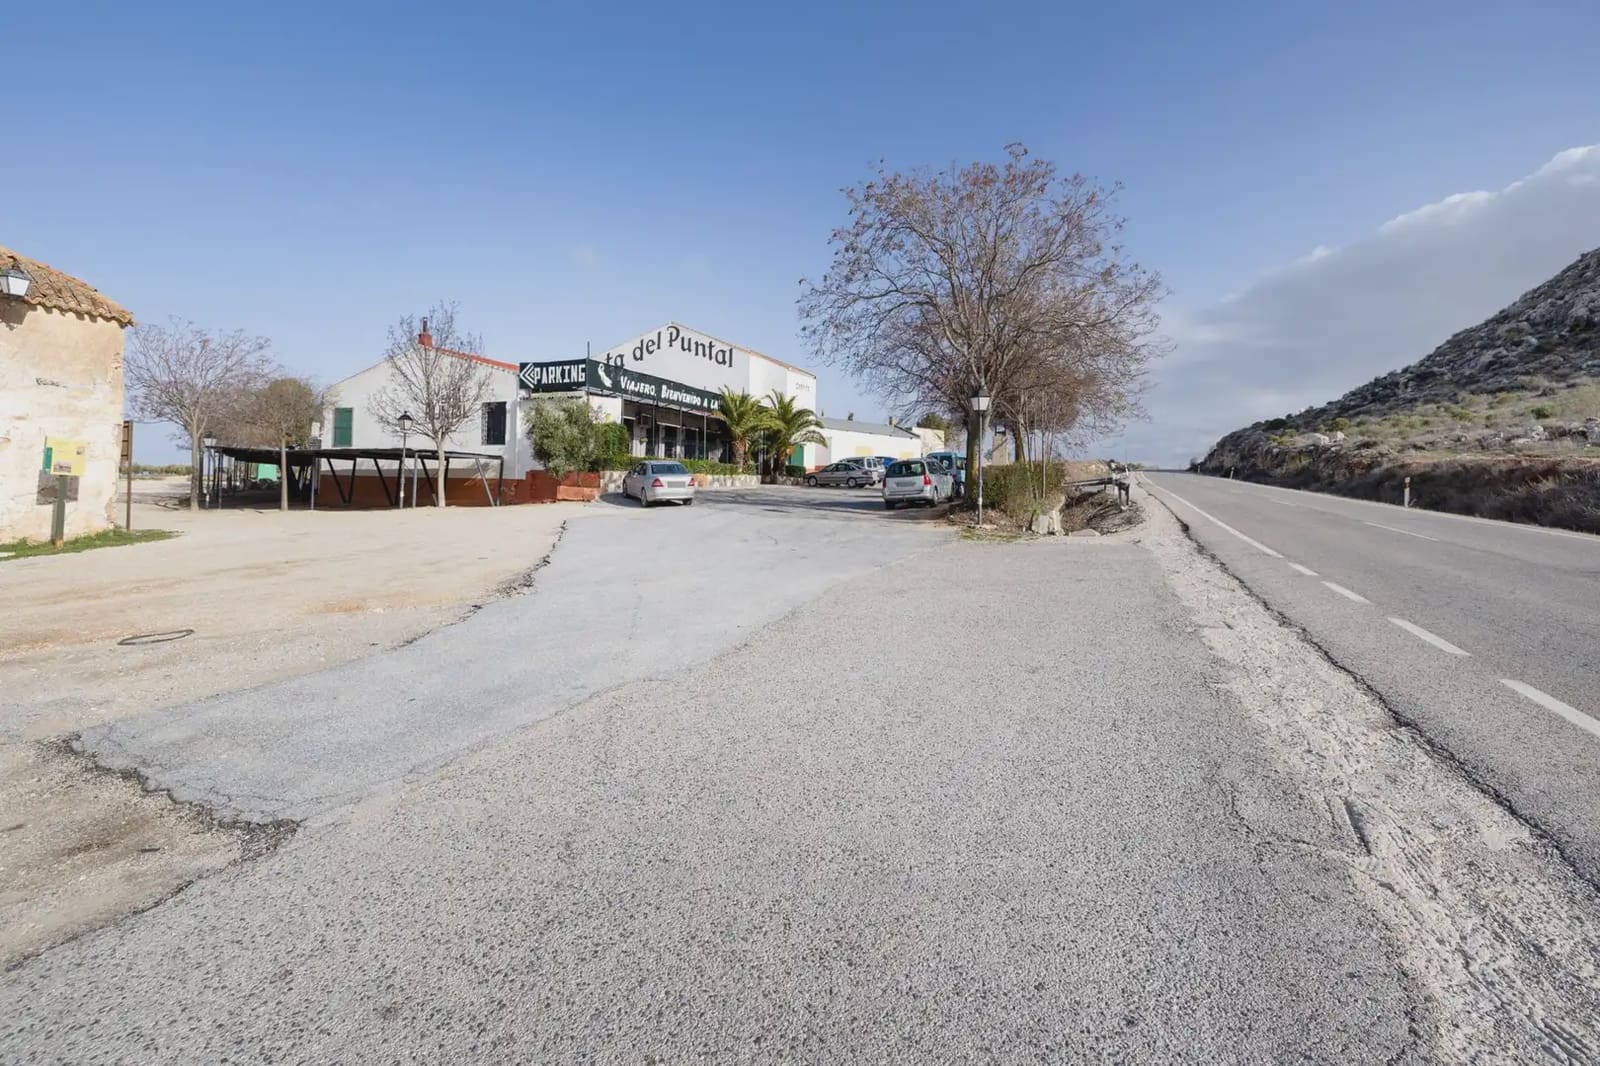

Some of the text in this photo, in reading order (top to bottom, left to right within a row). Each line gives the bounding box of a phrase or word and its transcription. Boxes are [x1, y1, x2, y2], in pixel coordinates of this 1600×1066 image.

[632, 331, 661, 361] del
[666, 325, 733, 368] Puntal
[534, 364, 586, 385] PARKING
[703, 398, 708, 409] A
